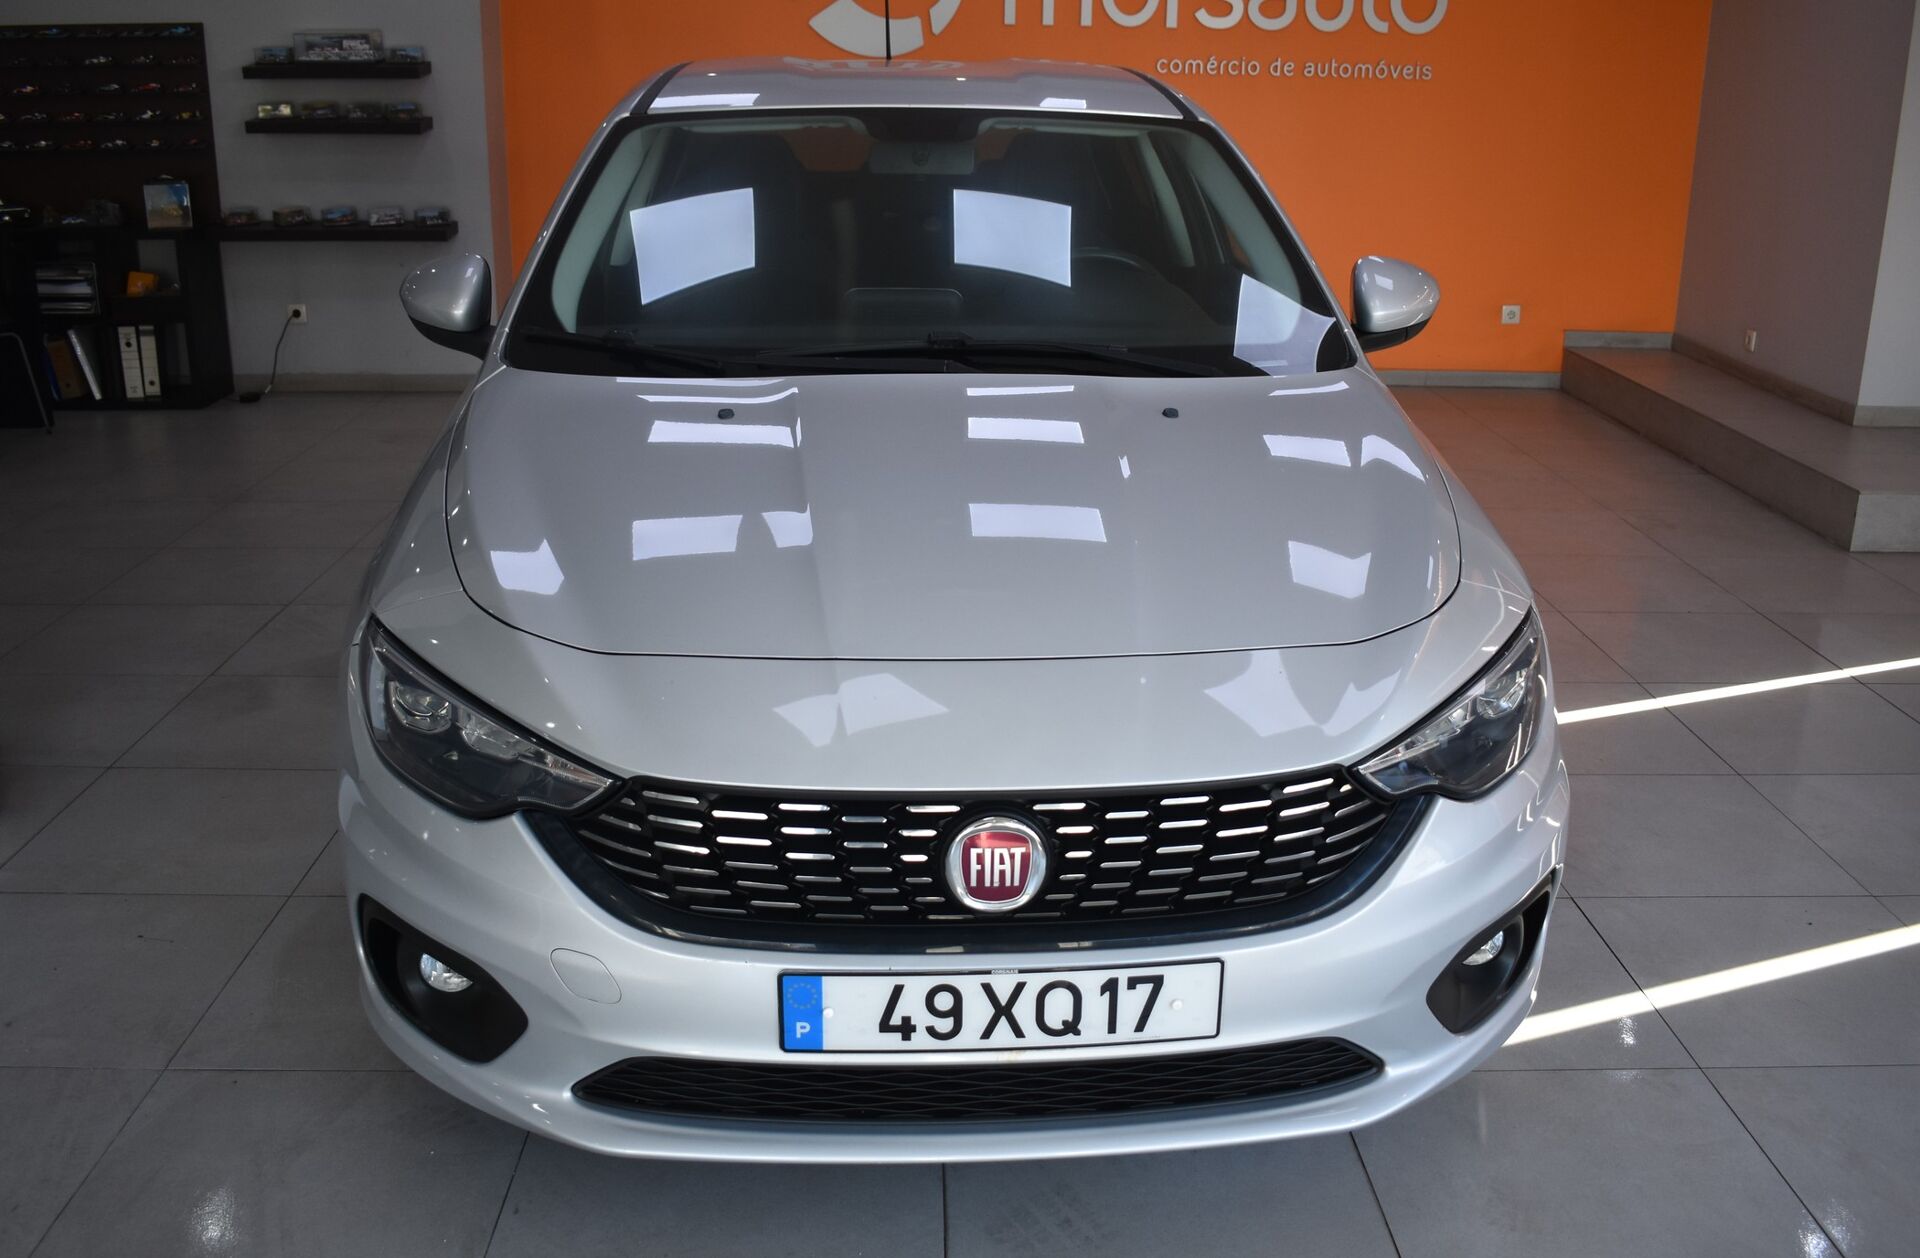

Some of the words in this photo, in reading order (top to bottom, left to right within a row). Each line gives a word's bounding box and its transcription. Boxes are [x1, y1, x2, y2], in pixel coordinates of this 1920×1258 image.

[1156, 56, 1260, 76] comércio
[1269, 57, 1295, 77] de
[1303, 59, 1433, 80] automóveis
[970, 847, 1027, 887] FIAT
[796, 1022, 811, 1039] P
